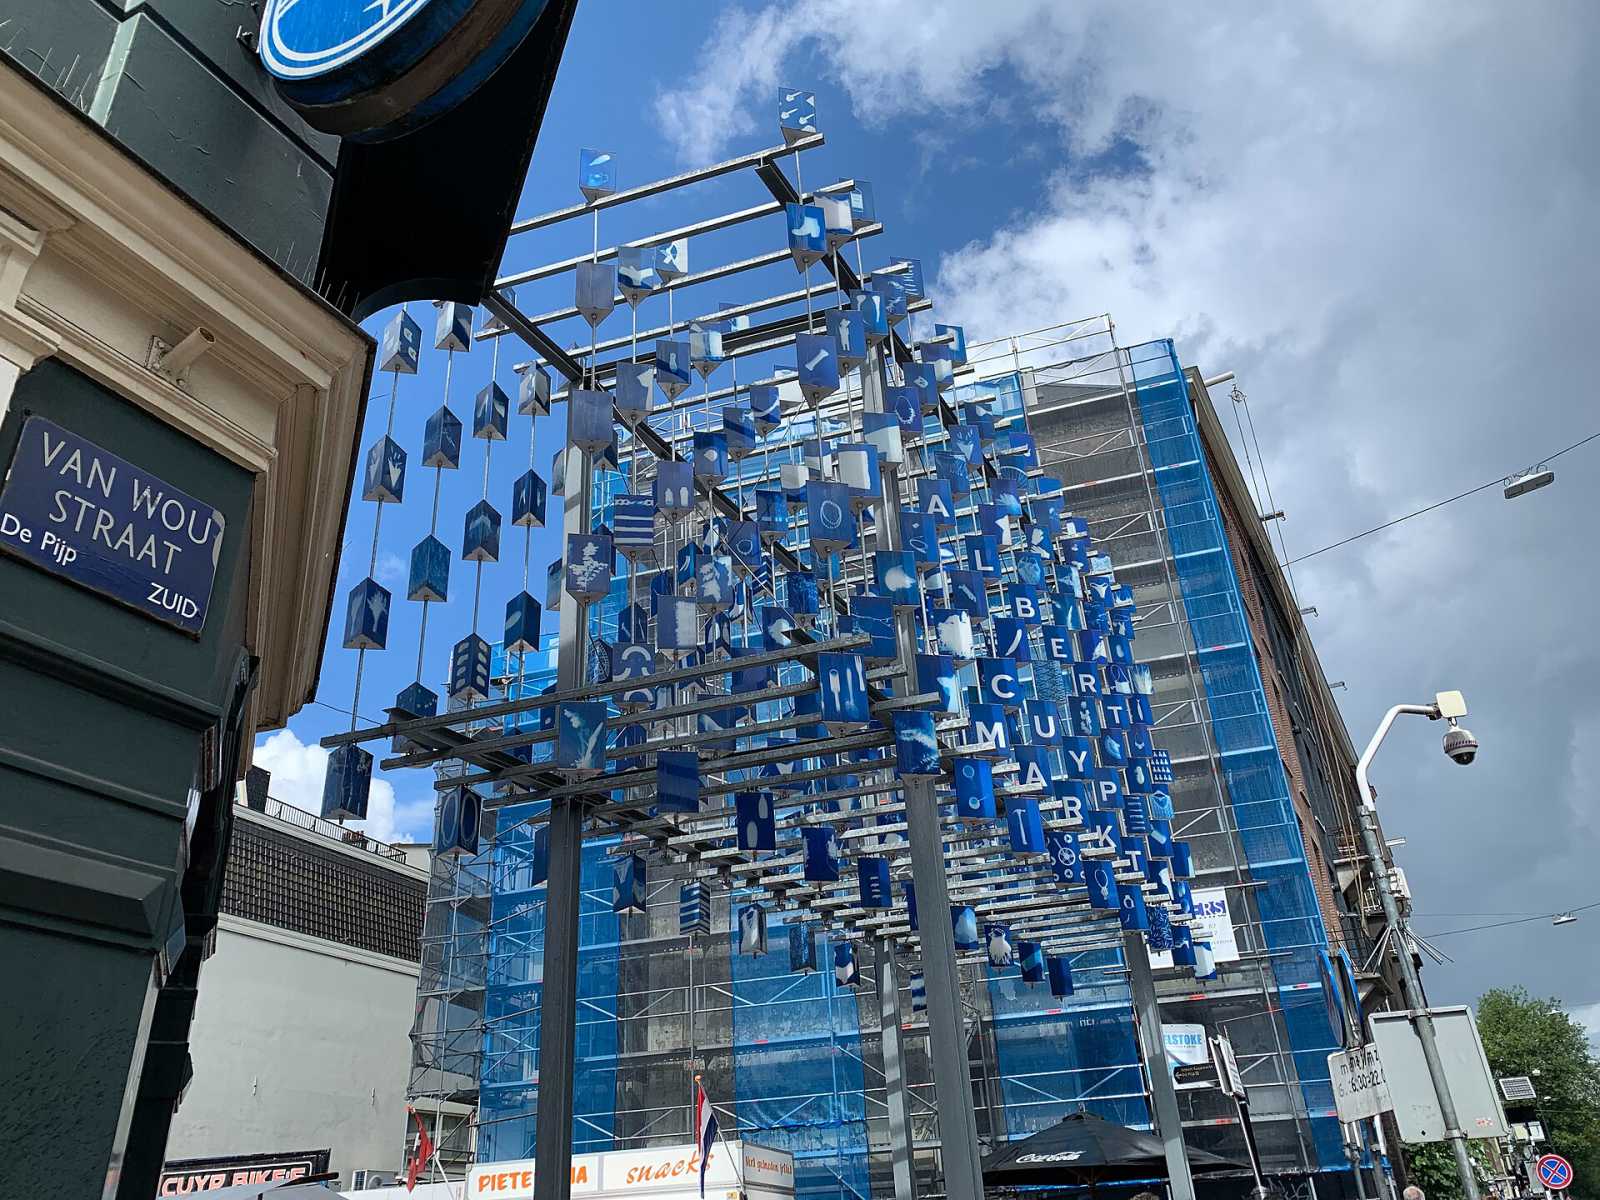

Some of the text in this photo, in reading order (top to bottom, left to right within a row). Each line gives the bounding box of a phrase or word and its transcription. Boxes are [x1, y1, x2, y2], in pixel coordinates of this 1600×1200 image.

[43, 431, 212, 545] VAN WOU
[0, 512, 78, 566] De Pijp
[49, 490, 183, 575] STRAAT
[147, 581, 199, 619] ZUID
[161, 1173, 227, 1198] CUYP
